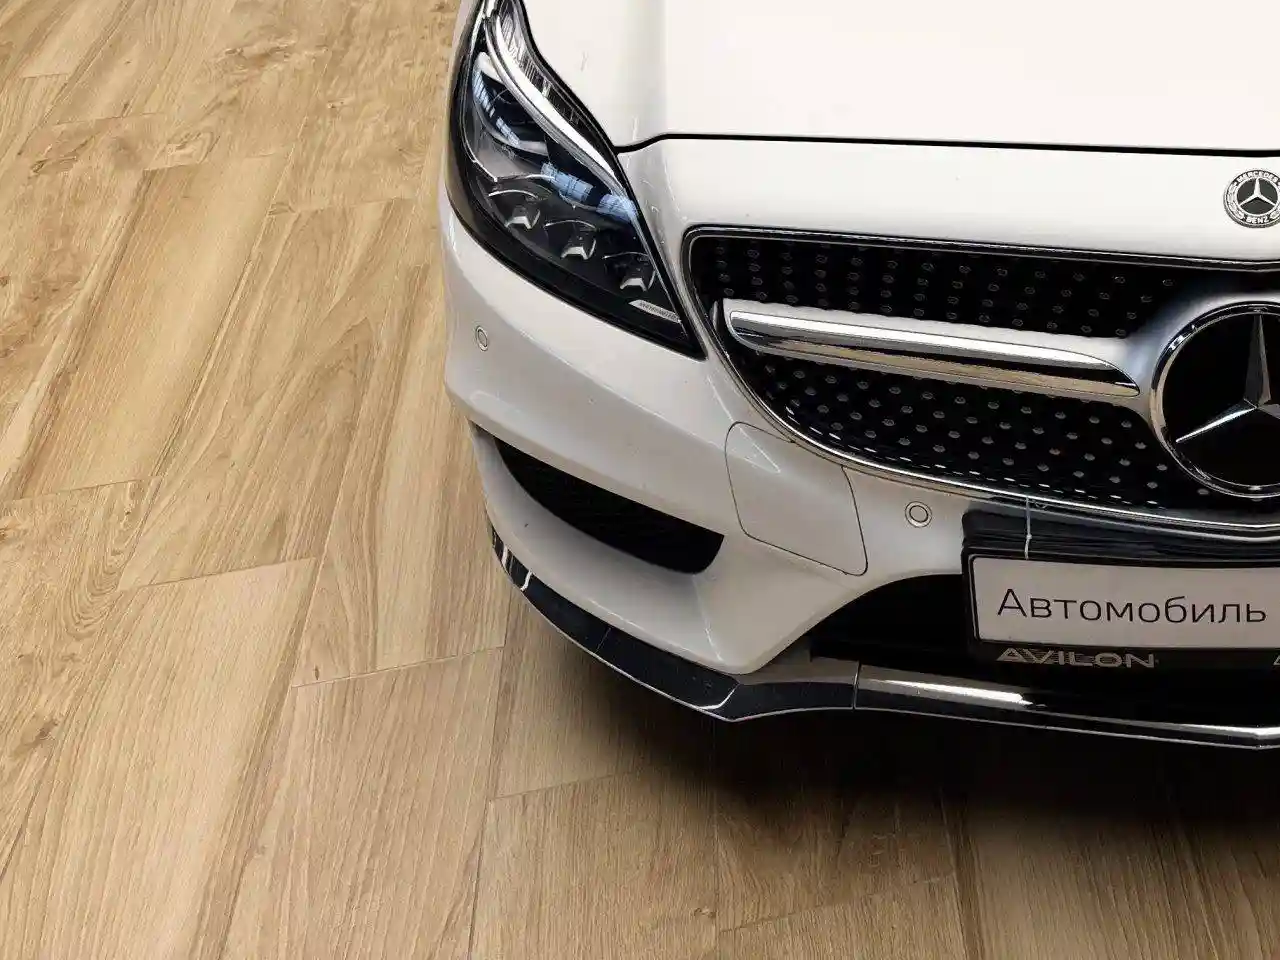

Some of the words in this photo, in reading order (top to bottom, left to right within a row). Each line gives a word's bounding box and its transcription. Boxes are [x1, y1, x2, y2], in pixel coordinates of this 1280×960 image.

[1236, 170, 1279, 183] MERCEDES
[1245, 216, 1270, 225] BENZ
[997, 588, 1267, 624] Автомобиль
[996, 647, 1157, 669] AVILON
